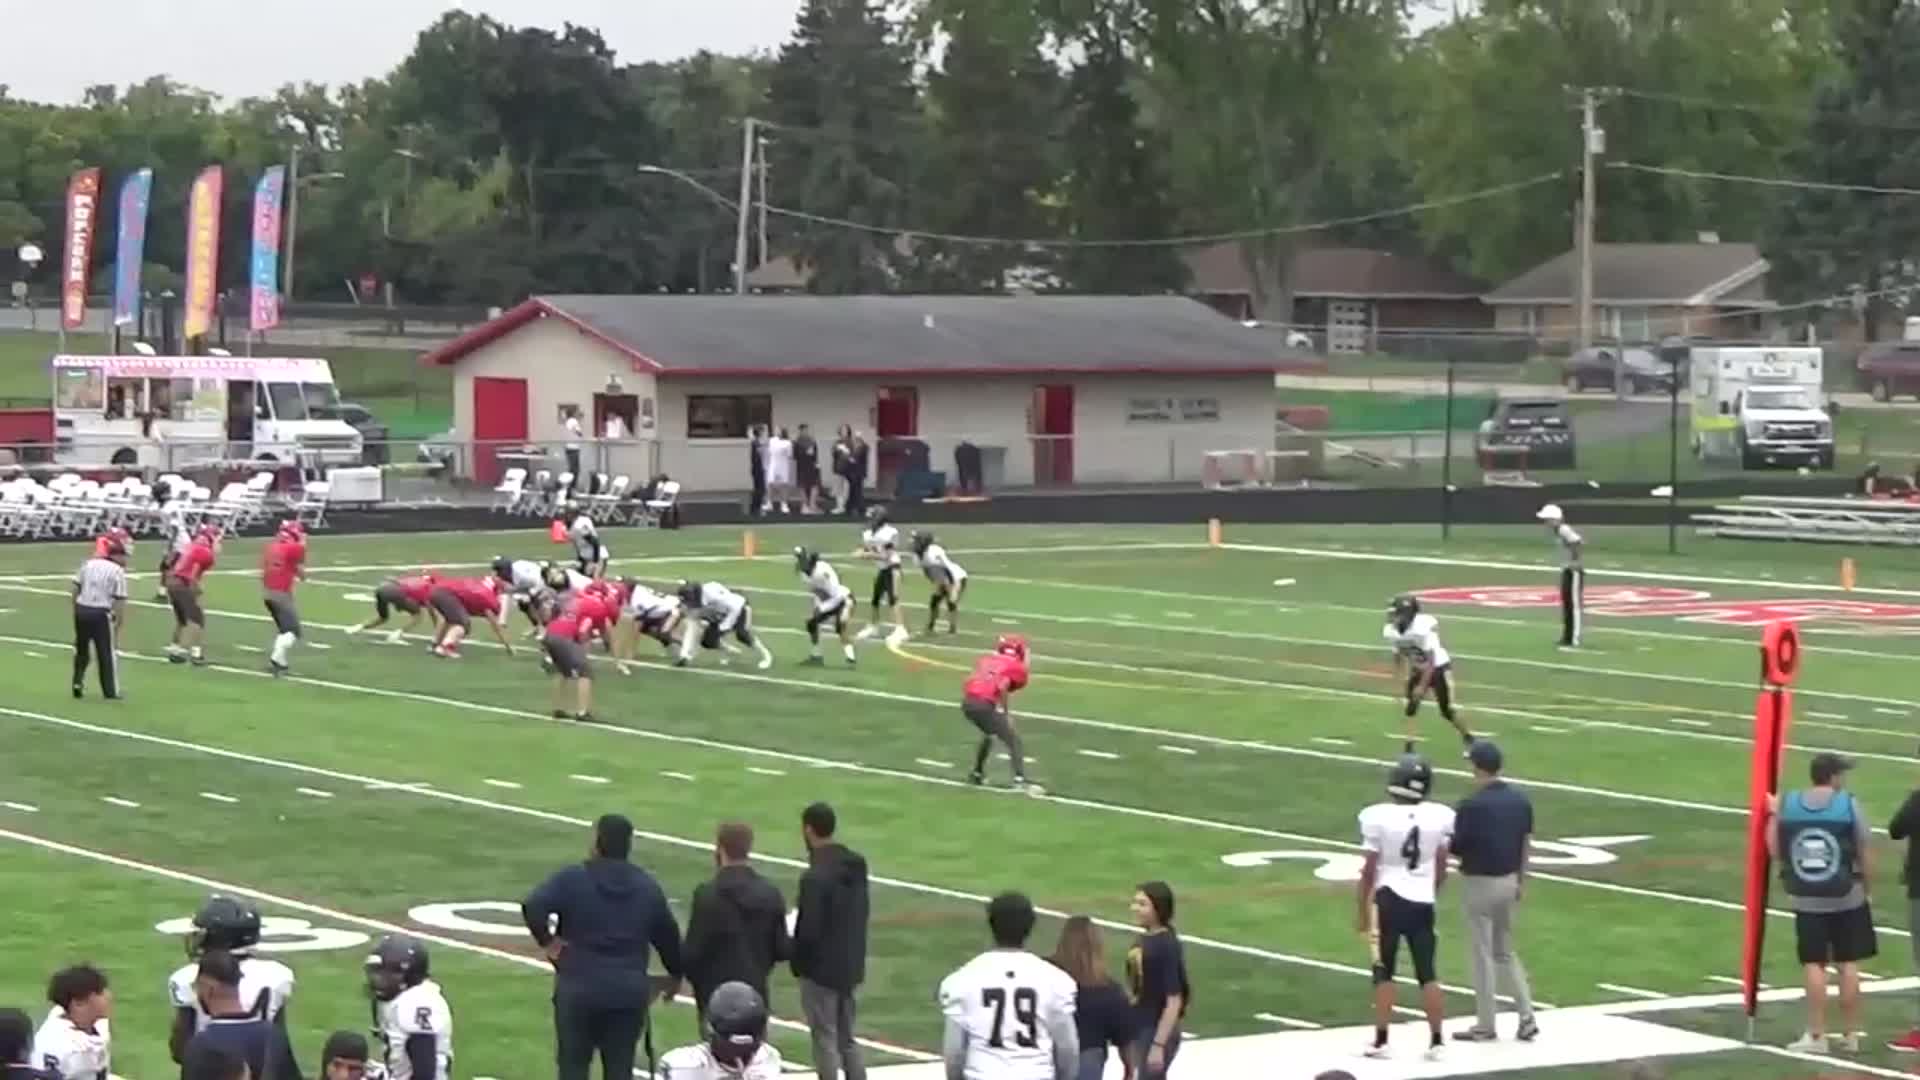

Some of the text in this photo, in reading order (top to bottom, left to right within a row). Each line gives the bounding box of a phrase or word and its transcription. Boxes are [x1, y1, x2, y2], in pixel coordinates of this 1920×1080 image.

[1401, 824, 1421, 871] 4
[415, 1006, 433, 1031] R
[981, 987, 1038, 1049] 79
